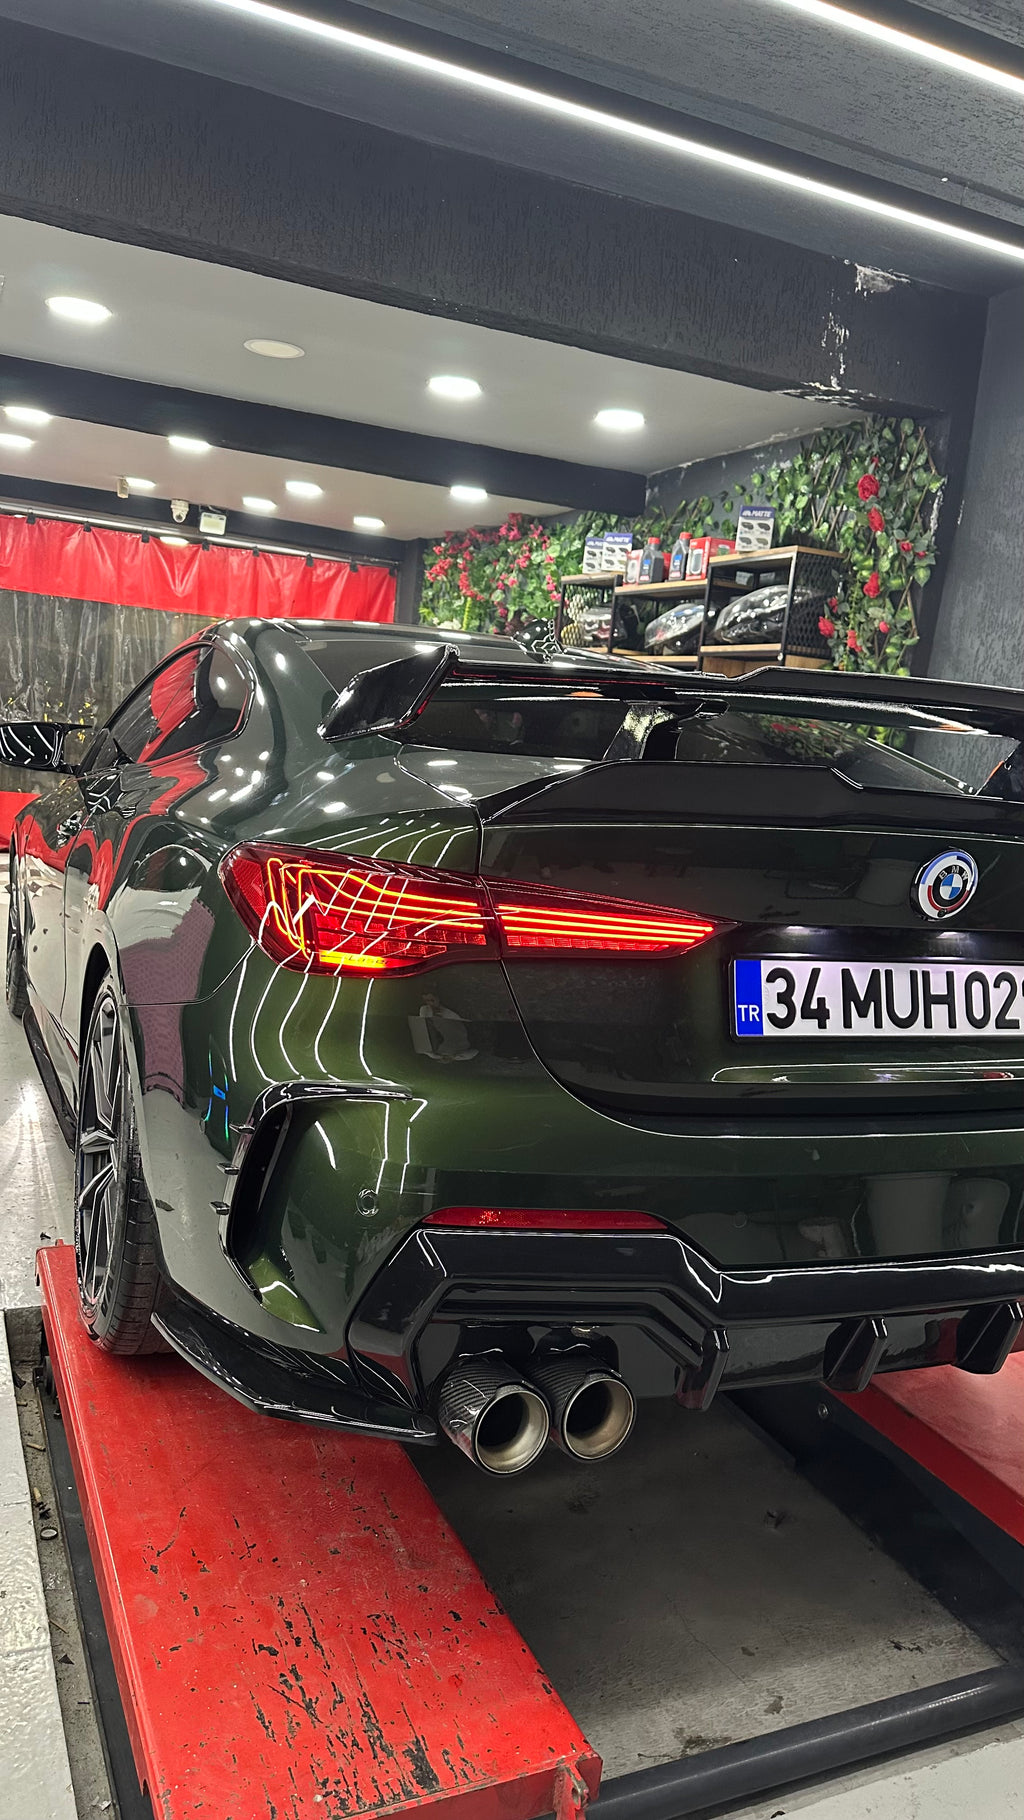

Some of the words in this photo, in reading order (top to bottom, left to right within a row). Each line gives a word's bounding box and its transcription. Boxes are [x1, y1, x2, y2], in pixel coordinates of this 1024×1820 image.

[938, 865, 969, 881] BMW
[766, 967, 830, 1029] 34
[841, 968, 957, 1029] MUH
[964, 970, 1024, 1029] 02
[738, 1004, 760, 1022] TR
